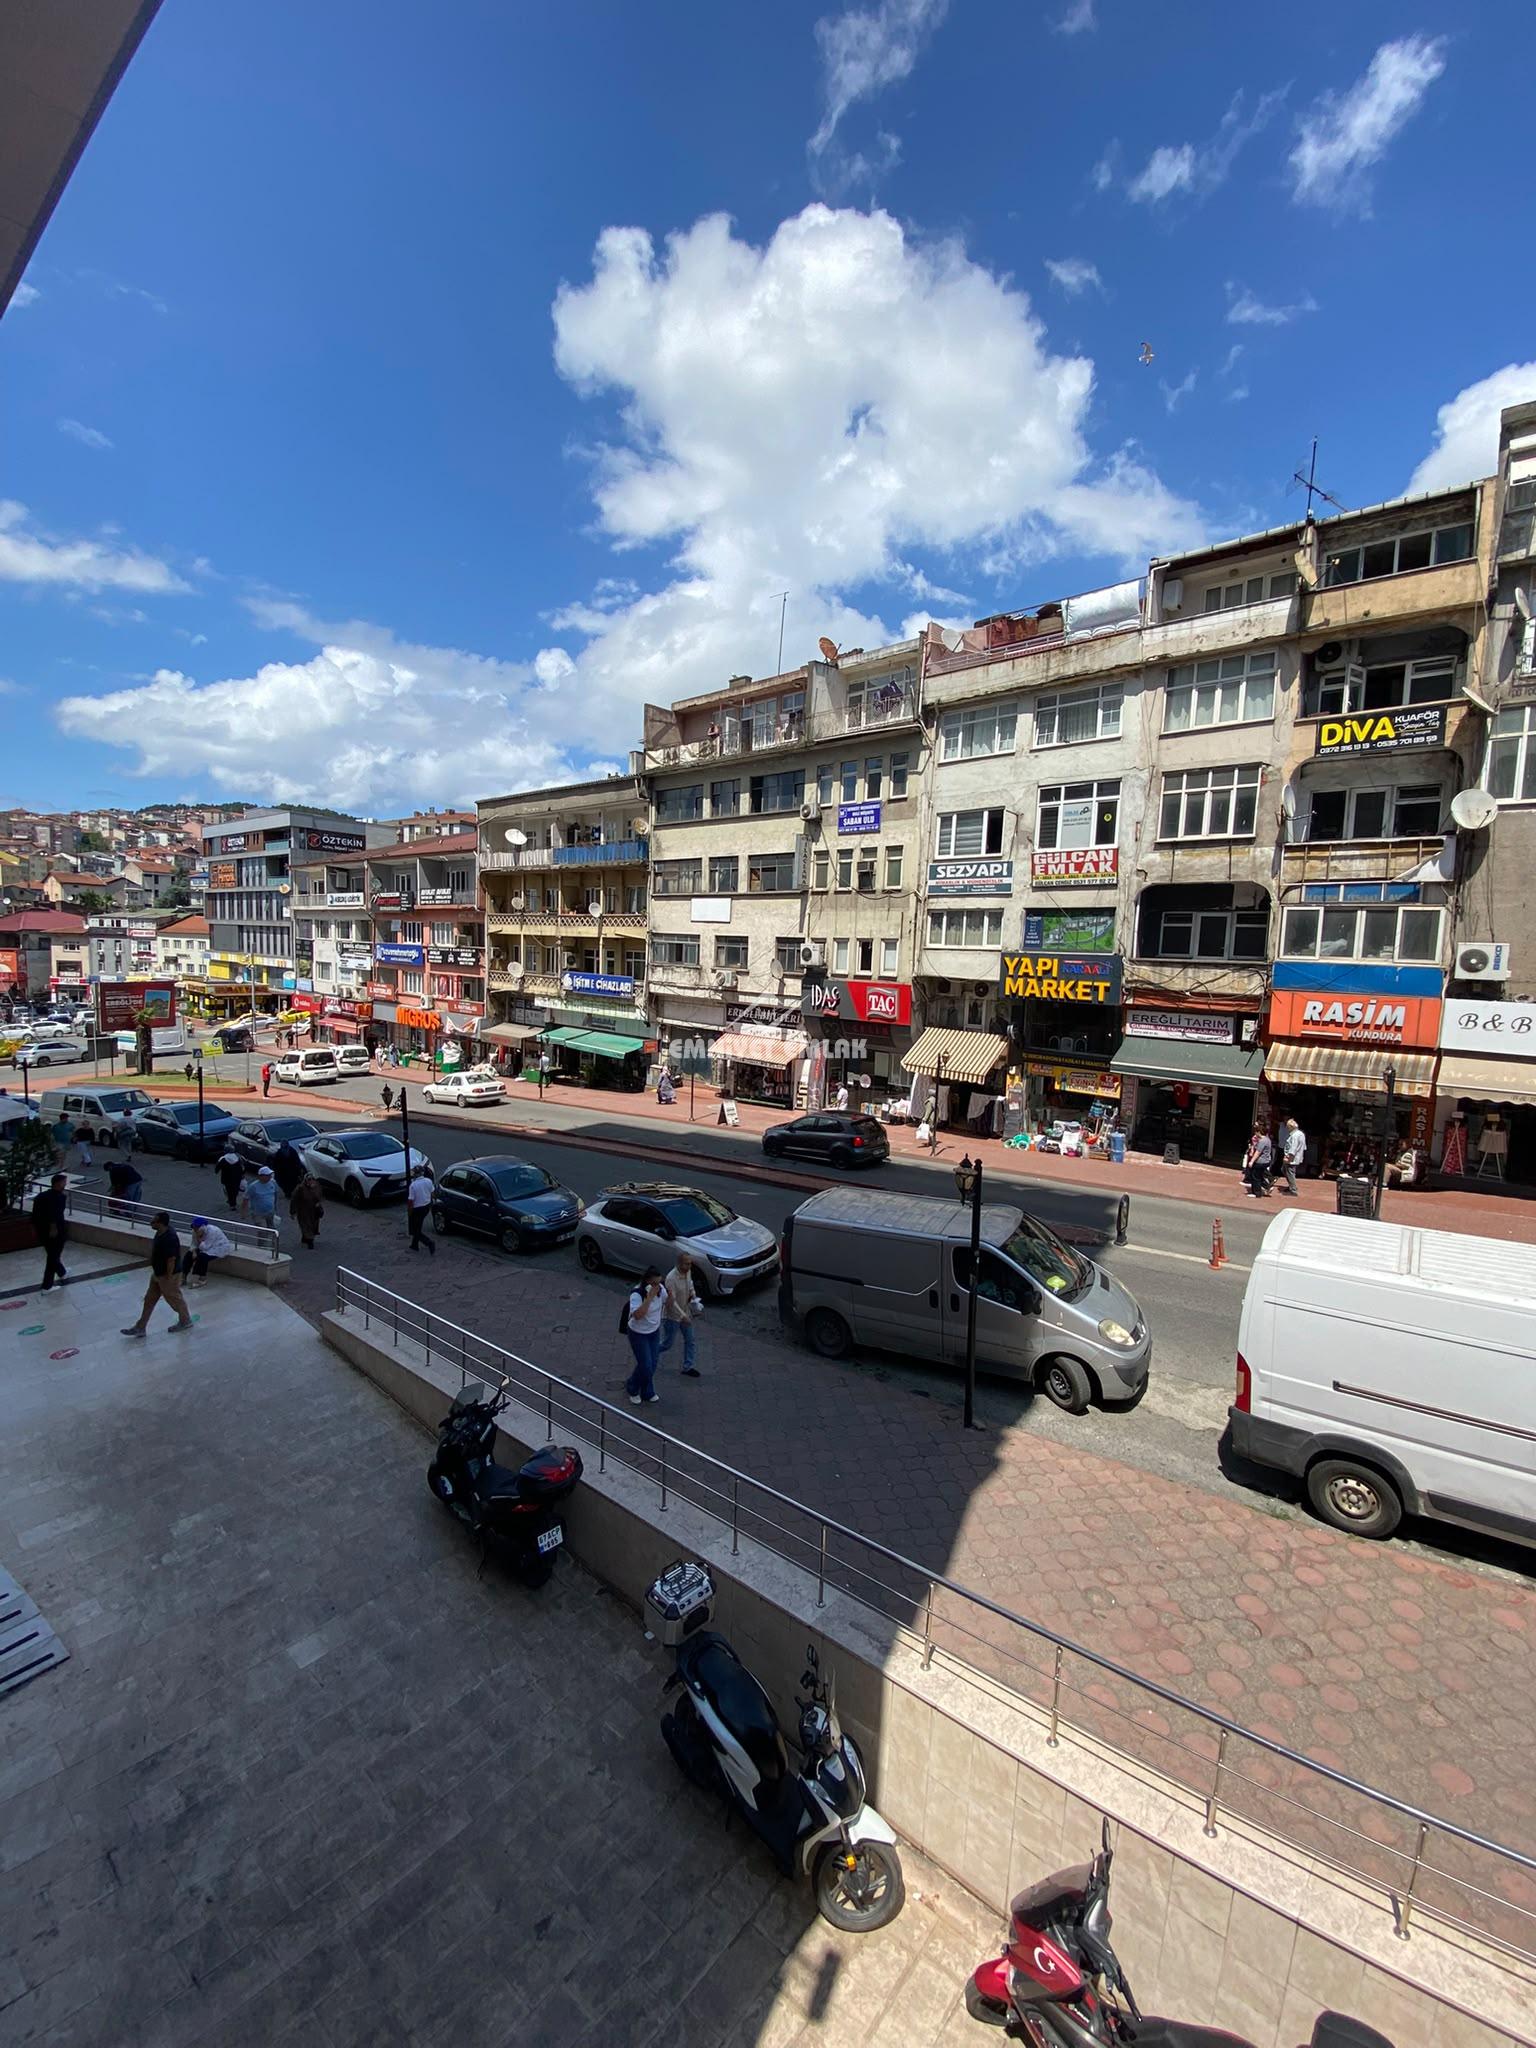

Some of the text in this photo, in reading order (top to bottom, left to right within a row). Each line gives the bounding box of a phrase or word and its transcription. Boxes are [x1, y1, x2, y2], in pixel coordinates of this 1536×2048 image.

[1395, 711, 1440, 723] KUAFÖR
[863, 815, 875, 824] ULU
[1034, 850, 1114, 865] GÜLCAN
[936, 863, 1008, 878] SEZYAPI
[1035, 861, 1115, 875] EMLAK
[1493, 945, 1502, 970] BEKO
[1004, 957, 1059, 977] YAPI
[1004, 977, 1110, 1002] MARKET
[869, 995, 895, 1015] TAÇ
[1132, 1014, 1228, 1029] EREĞLİ TARIM
[1458, 1013, 1533, 1034] B & B
[1349, 1028, 1403, 1042] KUNDURA
